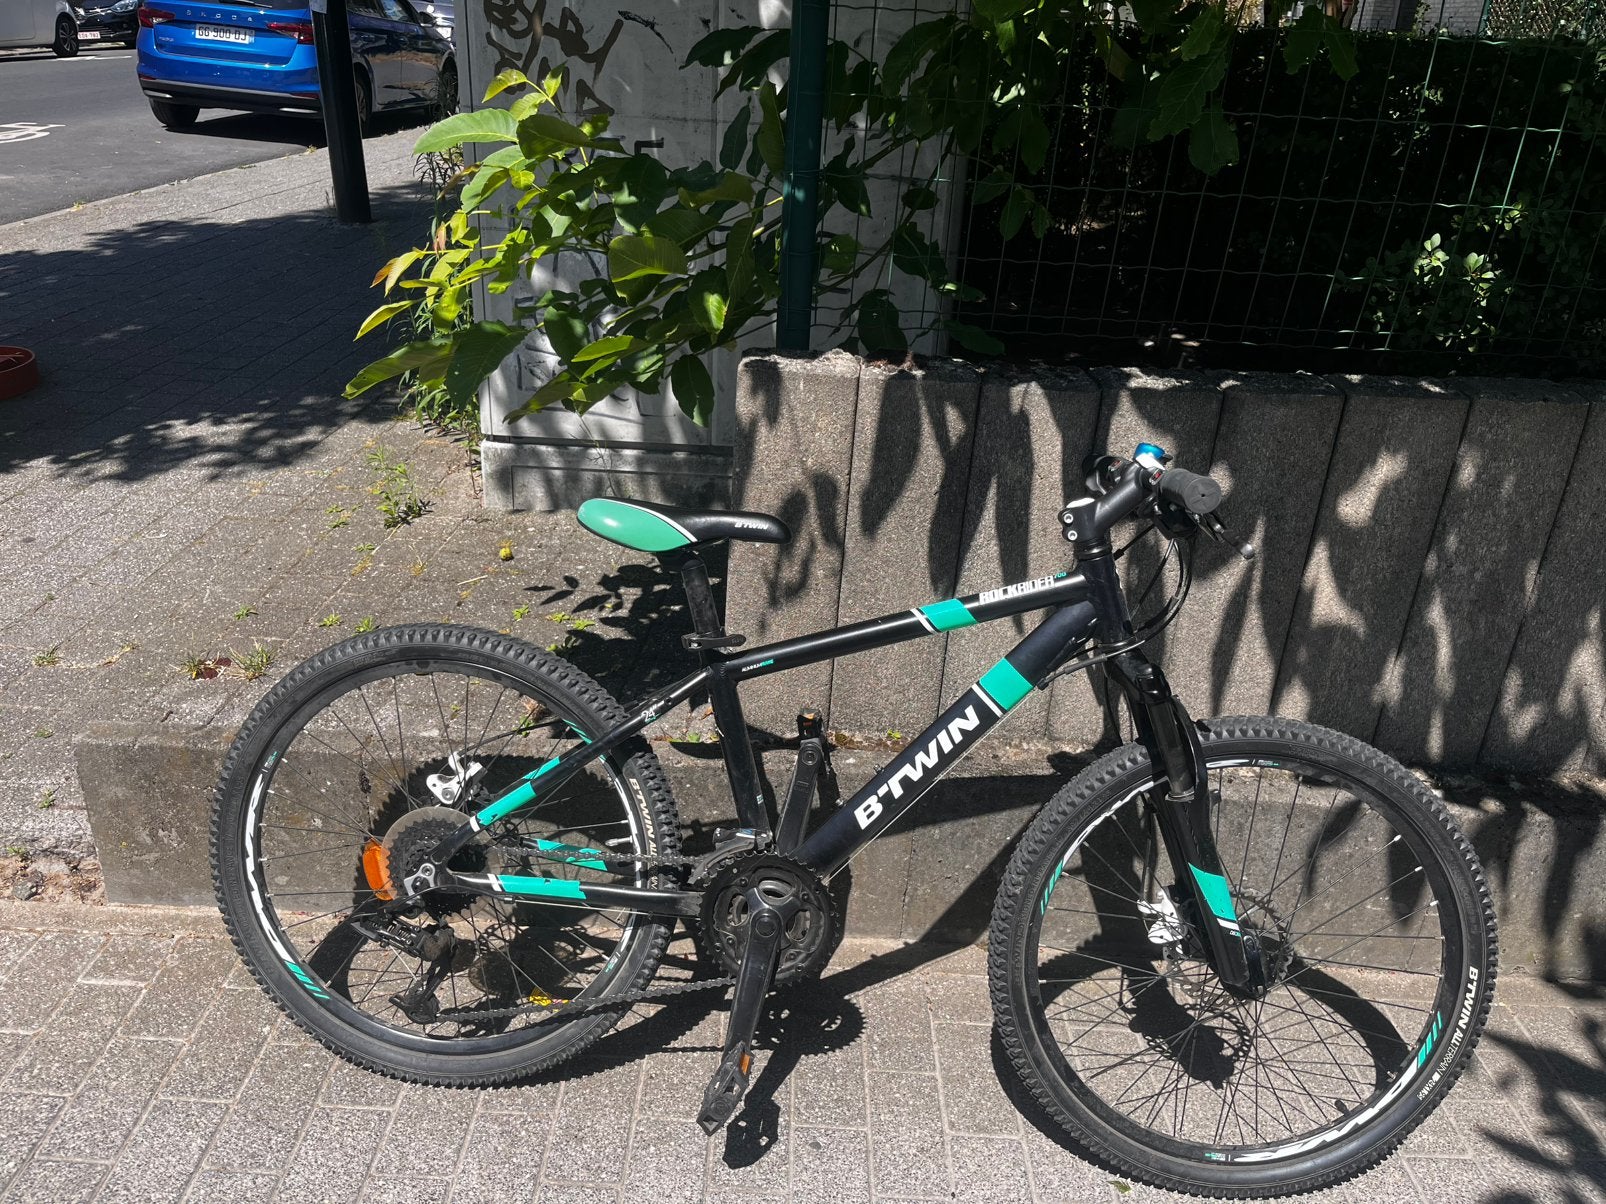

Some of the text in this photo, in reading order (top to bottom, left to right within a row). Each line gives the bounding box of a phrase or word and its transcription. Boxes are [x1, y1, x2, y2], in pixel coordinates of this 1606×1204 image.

[979, 575, 1055, 605] ROCKRIDER
[853, 704, 980, 830] B'TWIN
[1458, 965, 1479, 1029] B'TWIN
